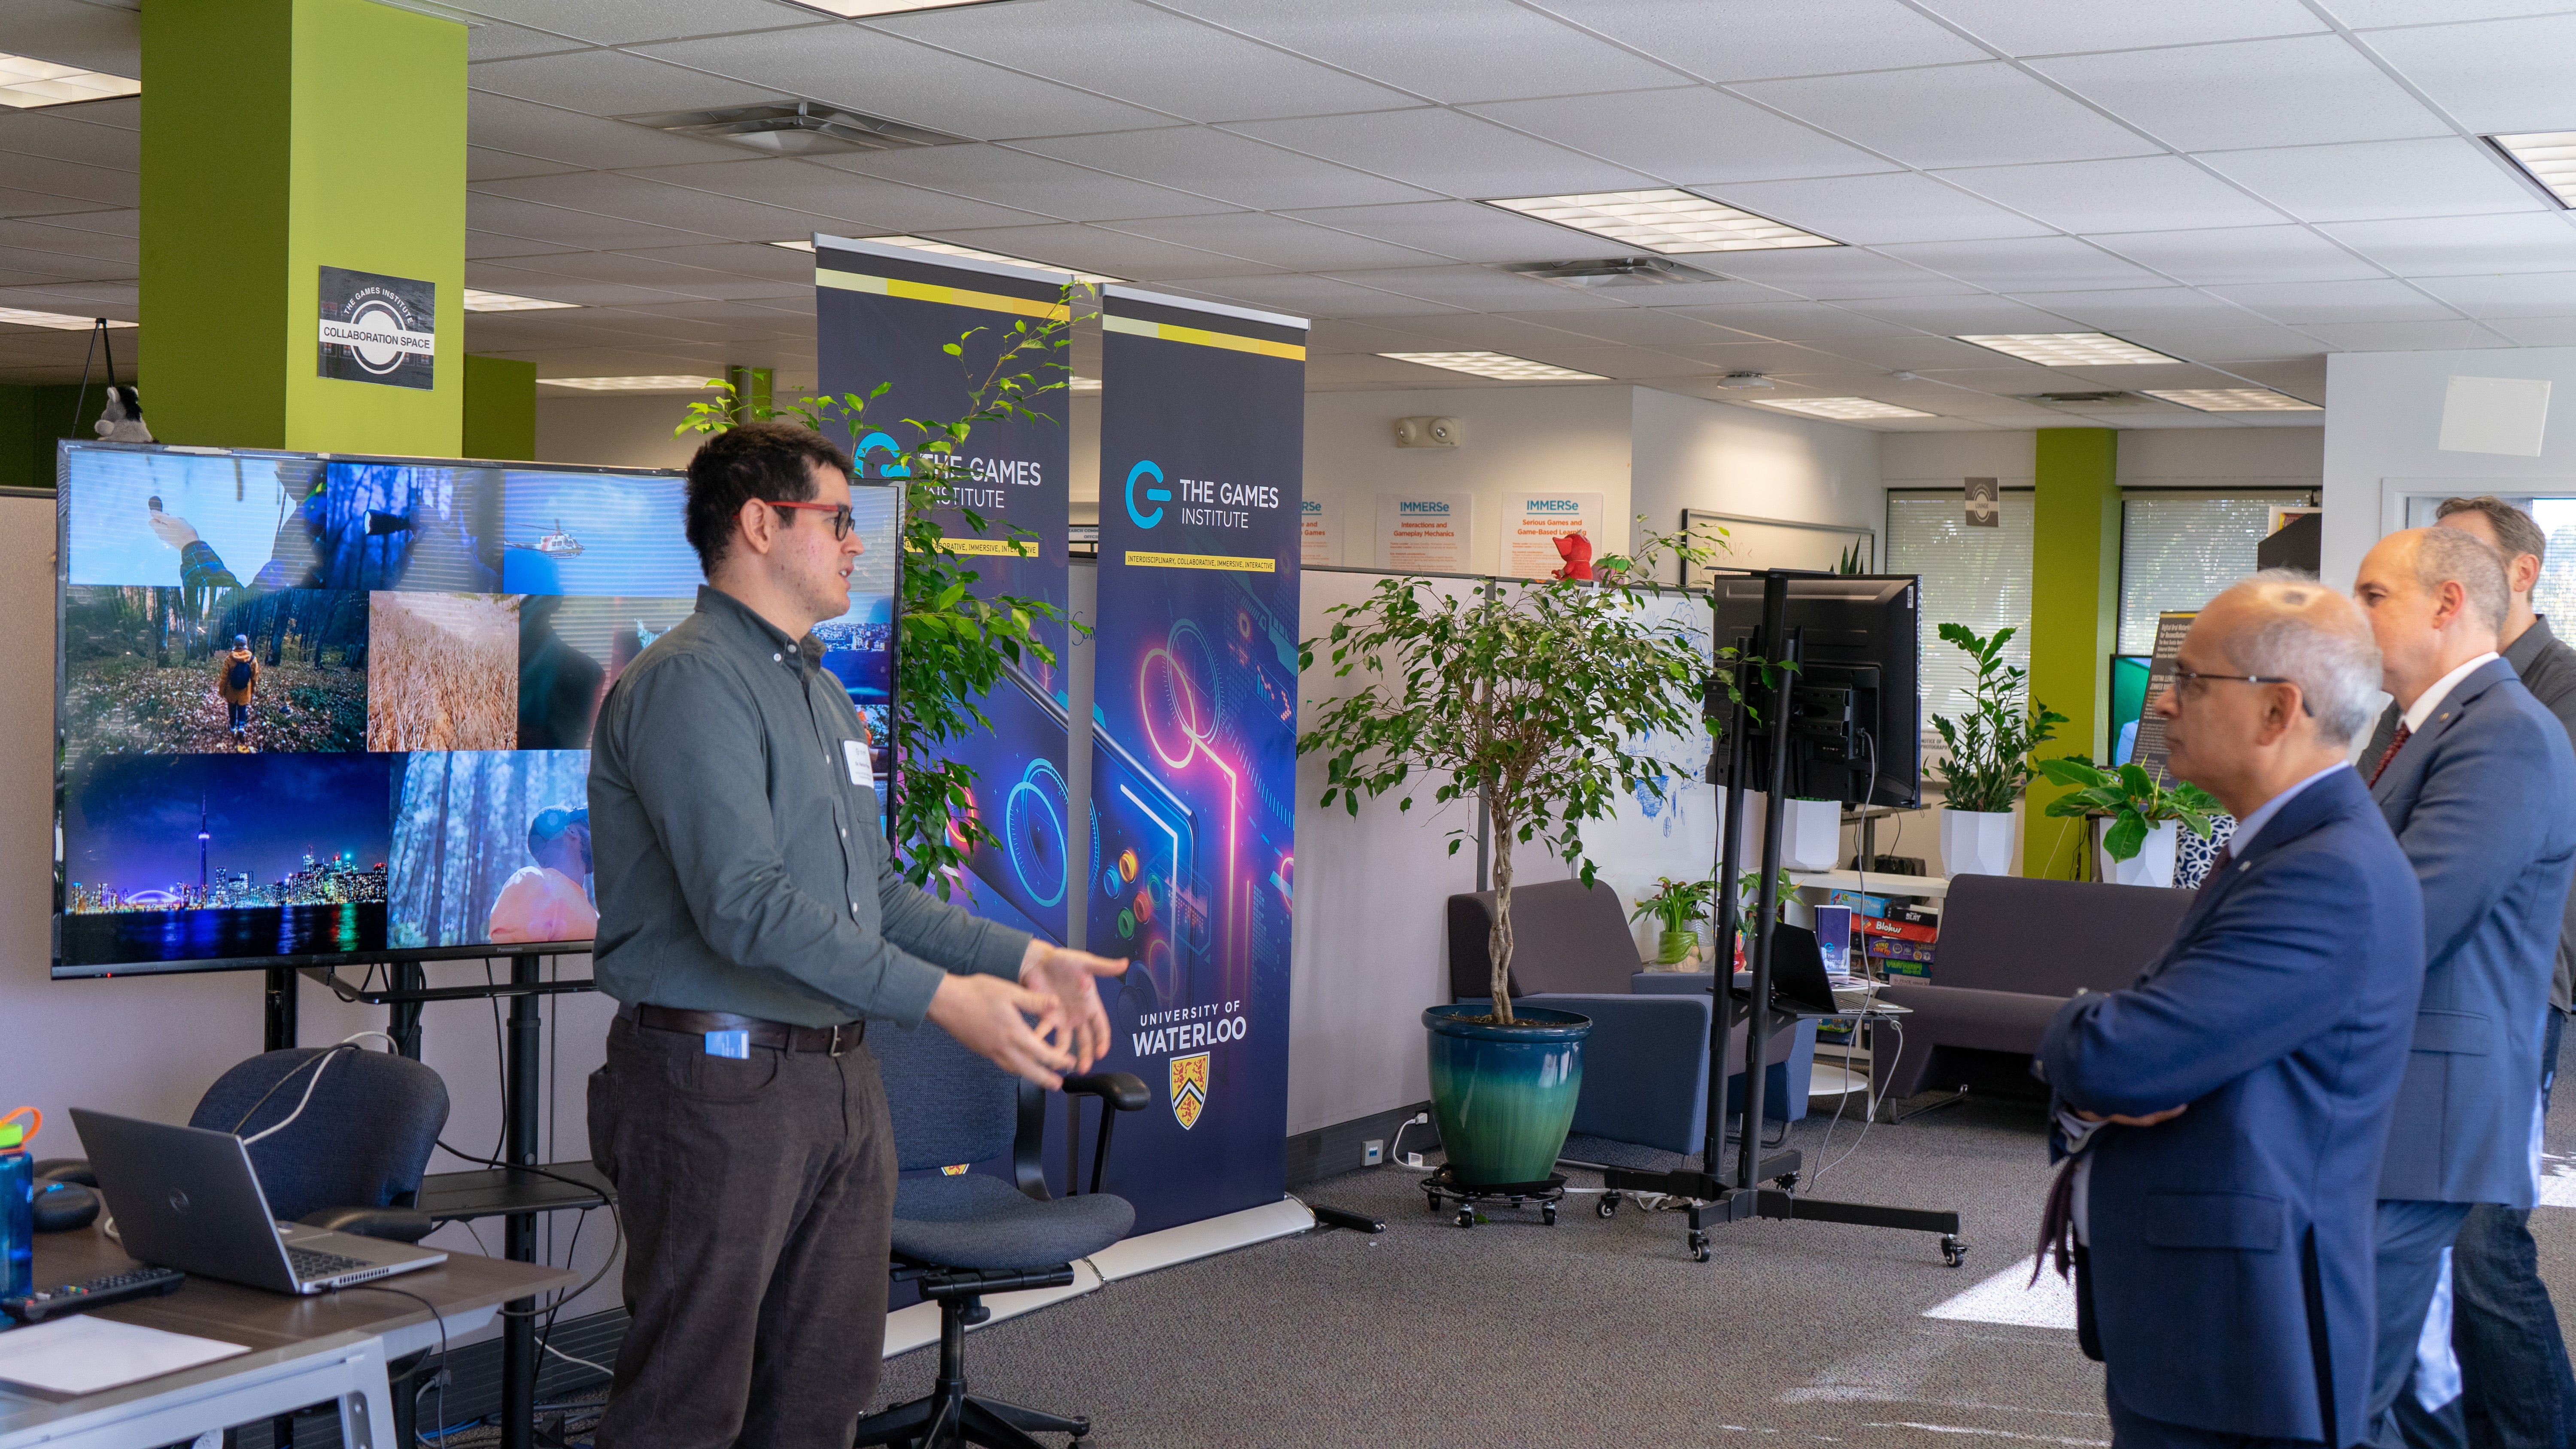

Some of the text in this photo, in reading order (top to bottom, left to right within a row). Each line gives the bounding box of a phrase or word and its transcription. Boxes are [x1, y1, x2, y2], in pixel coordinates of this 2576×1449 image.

[344, 287, 413, 324] THE GAMES INSTITUTE
[324, 327, 430, 349] COLLABORATION SPACE
[920, 453, 1041, 486] THE GAMES
[924, 485, 1004, 508] NSTITUTE
[1180, 479, 1279, 508] THE GAMES
[1400, 502, 1449, 512] IMMERSe
[1527, 500, 1578, 511] IMMERSe
[1182, 508, 1249, 528] INSTITUTE
[969, 544, 1000, 552] IMMERSIVE,
[1128, 555, 1176, 565] INTERDISCIPLINARY,
[1177, 558, 1216, 567] COLLABORATIVE,
[1217, 561, 1244, 569] IMMERSIVE,
[1876, 921, 1902, 934] Blokus
[1140, 1000, 1240, 1027] UNIVERSITY OF
[1132, 1016, 1246, 1057] WATERLOO
